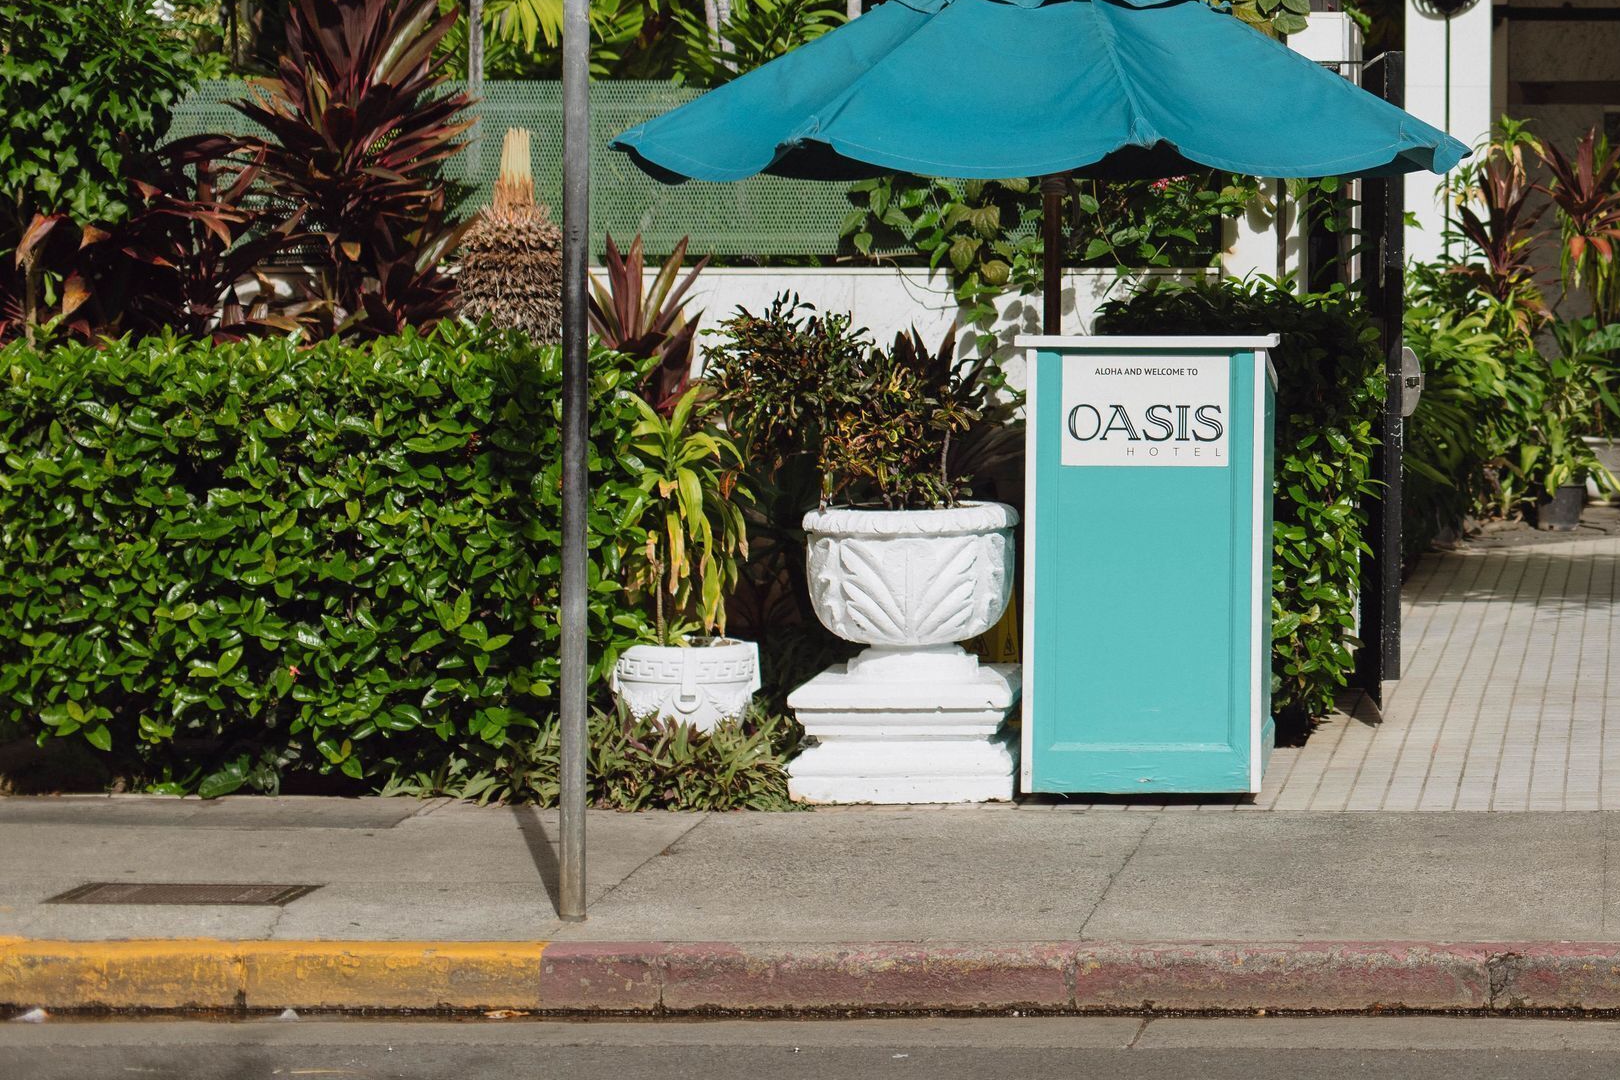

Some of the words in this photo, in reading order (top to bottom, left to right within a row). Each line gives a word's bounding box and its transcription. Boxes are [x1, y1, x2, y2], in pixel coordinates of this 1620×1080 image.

[1125, 368, 1142, 376] AND
[1144, 368, 1185, 376] WELCOME
[1187, 368, 1198, 376] TO
[1068, 404, 1223, 442] OASIS
[1126, 447, 1221, 457] HOTEL
